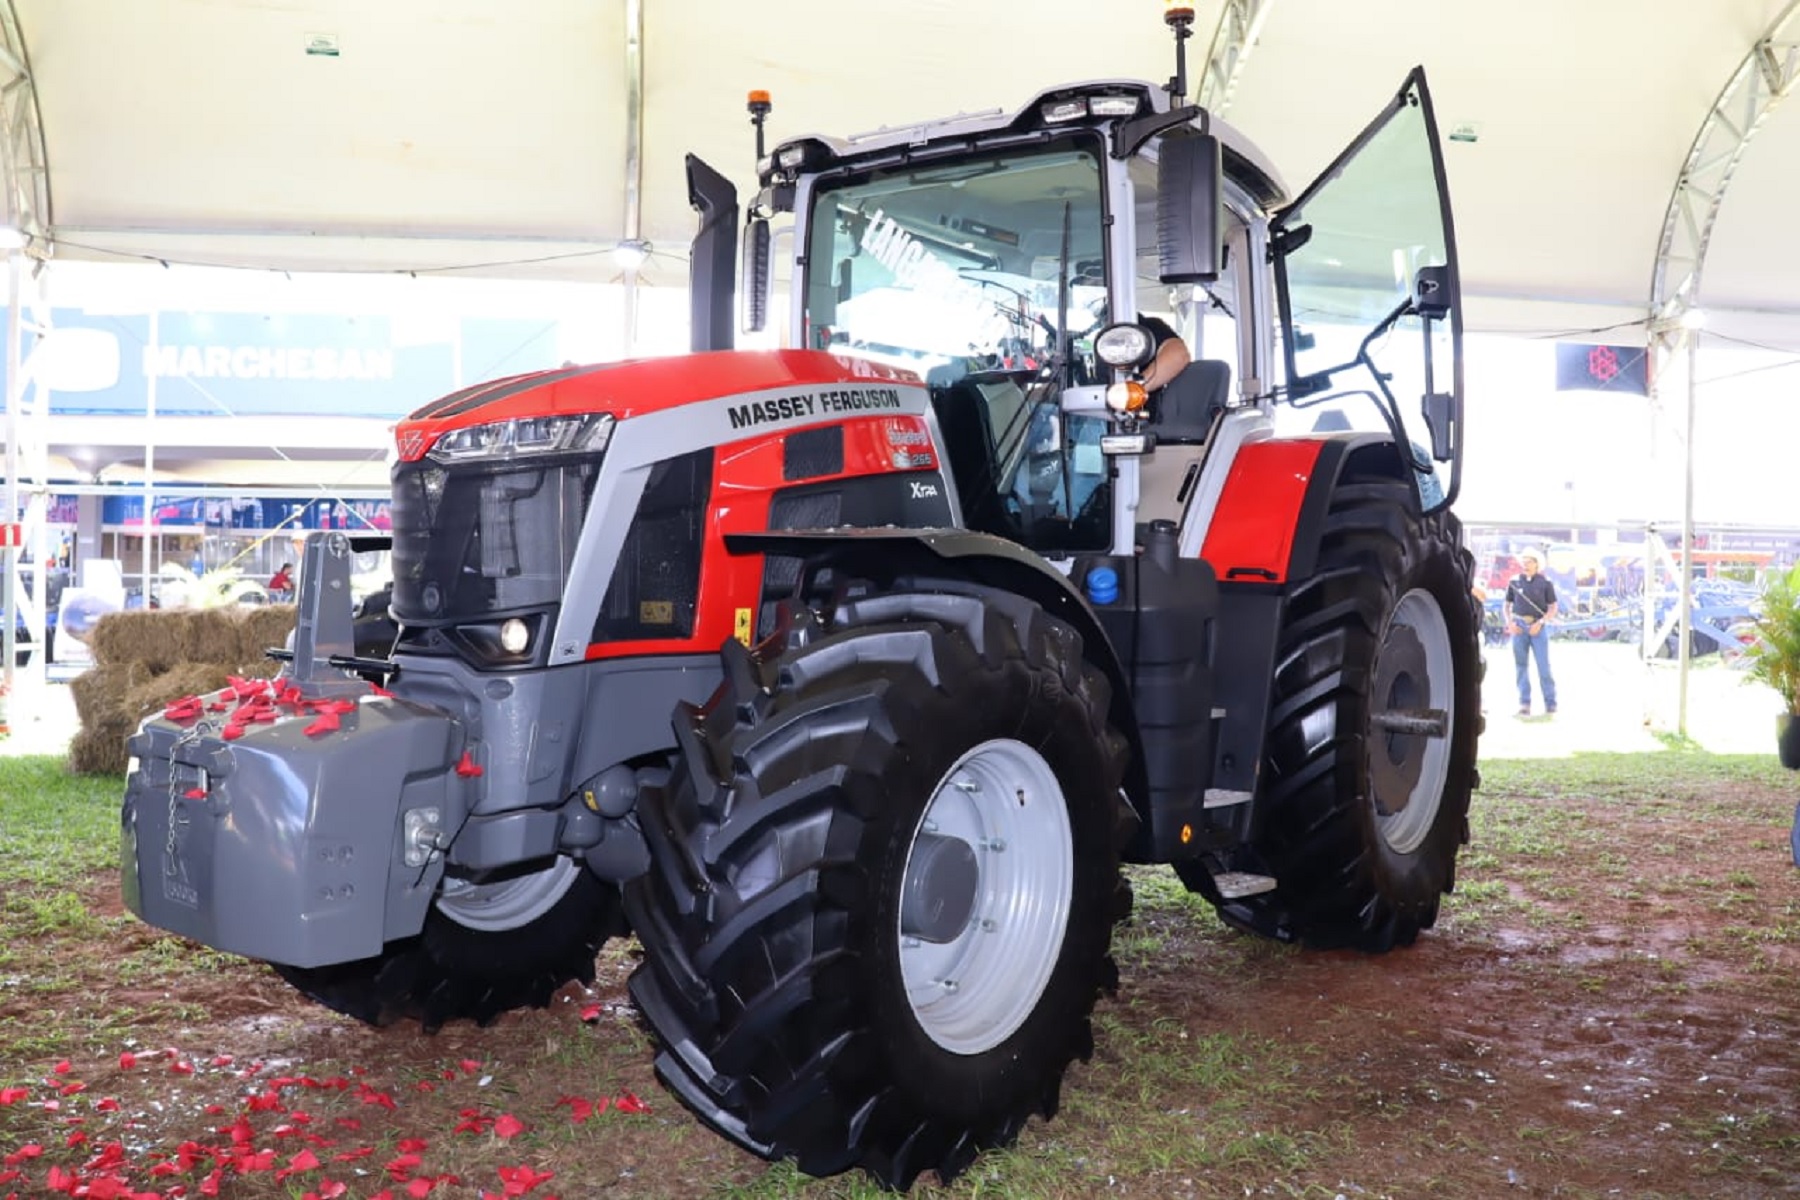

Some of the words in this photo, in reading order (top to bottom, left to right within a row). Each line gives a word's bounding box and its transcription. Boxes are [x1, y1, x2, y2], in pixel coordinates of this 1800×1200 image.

[143, 345, 393, 379] MARCHESAN
[728, 394, 814, 429] MASSEY
[819, 389, 900, 413] FERGUSON
